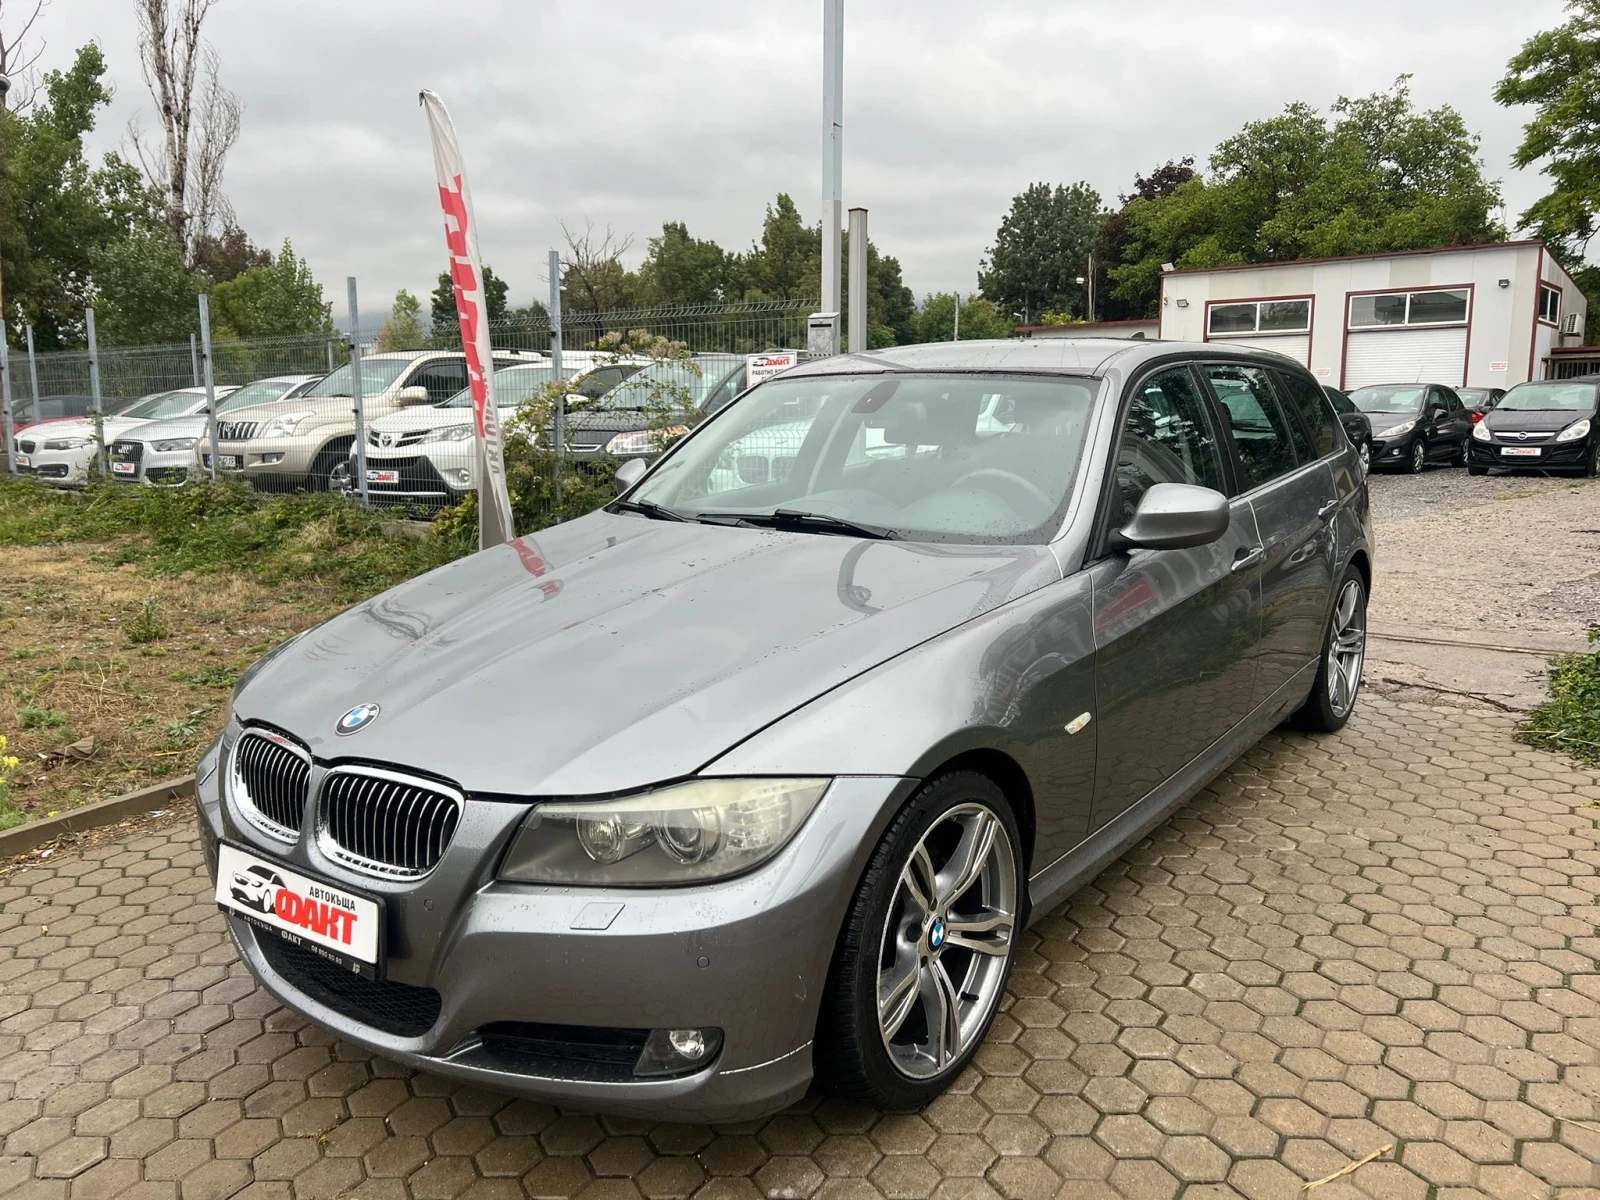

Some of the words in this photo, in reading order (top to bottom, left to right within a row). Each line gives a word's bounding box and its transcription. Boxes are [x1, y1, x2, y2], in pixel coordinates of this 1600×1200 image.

[309, 886, 356, 911] АВТОКЪЩА
[275, 888, 358, 945] ФАКТ
[281, 930, 303, 947] ФАКТ
